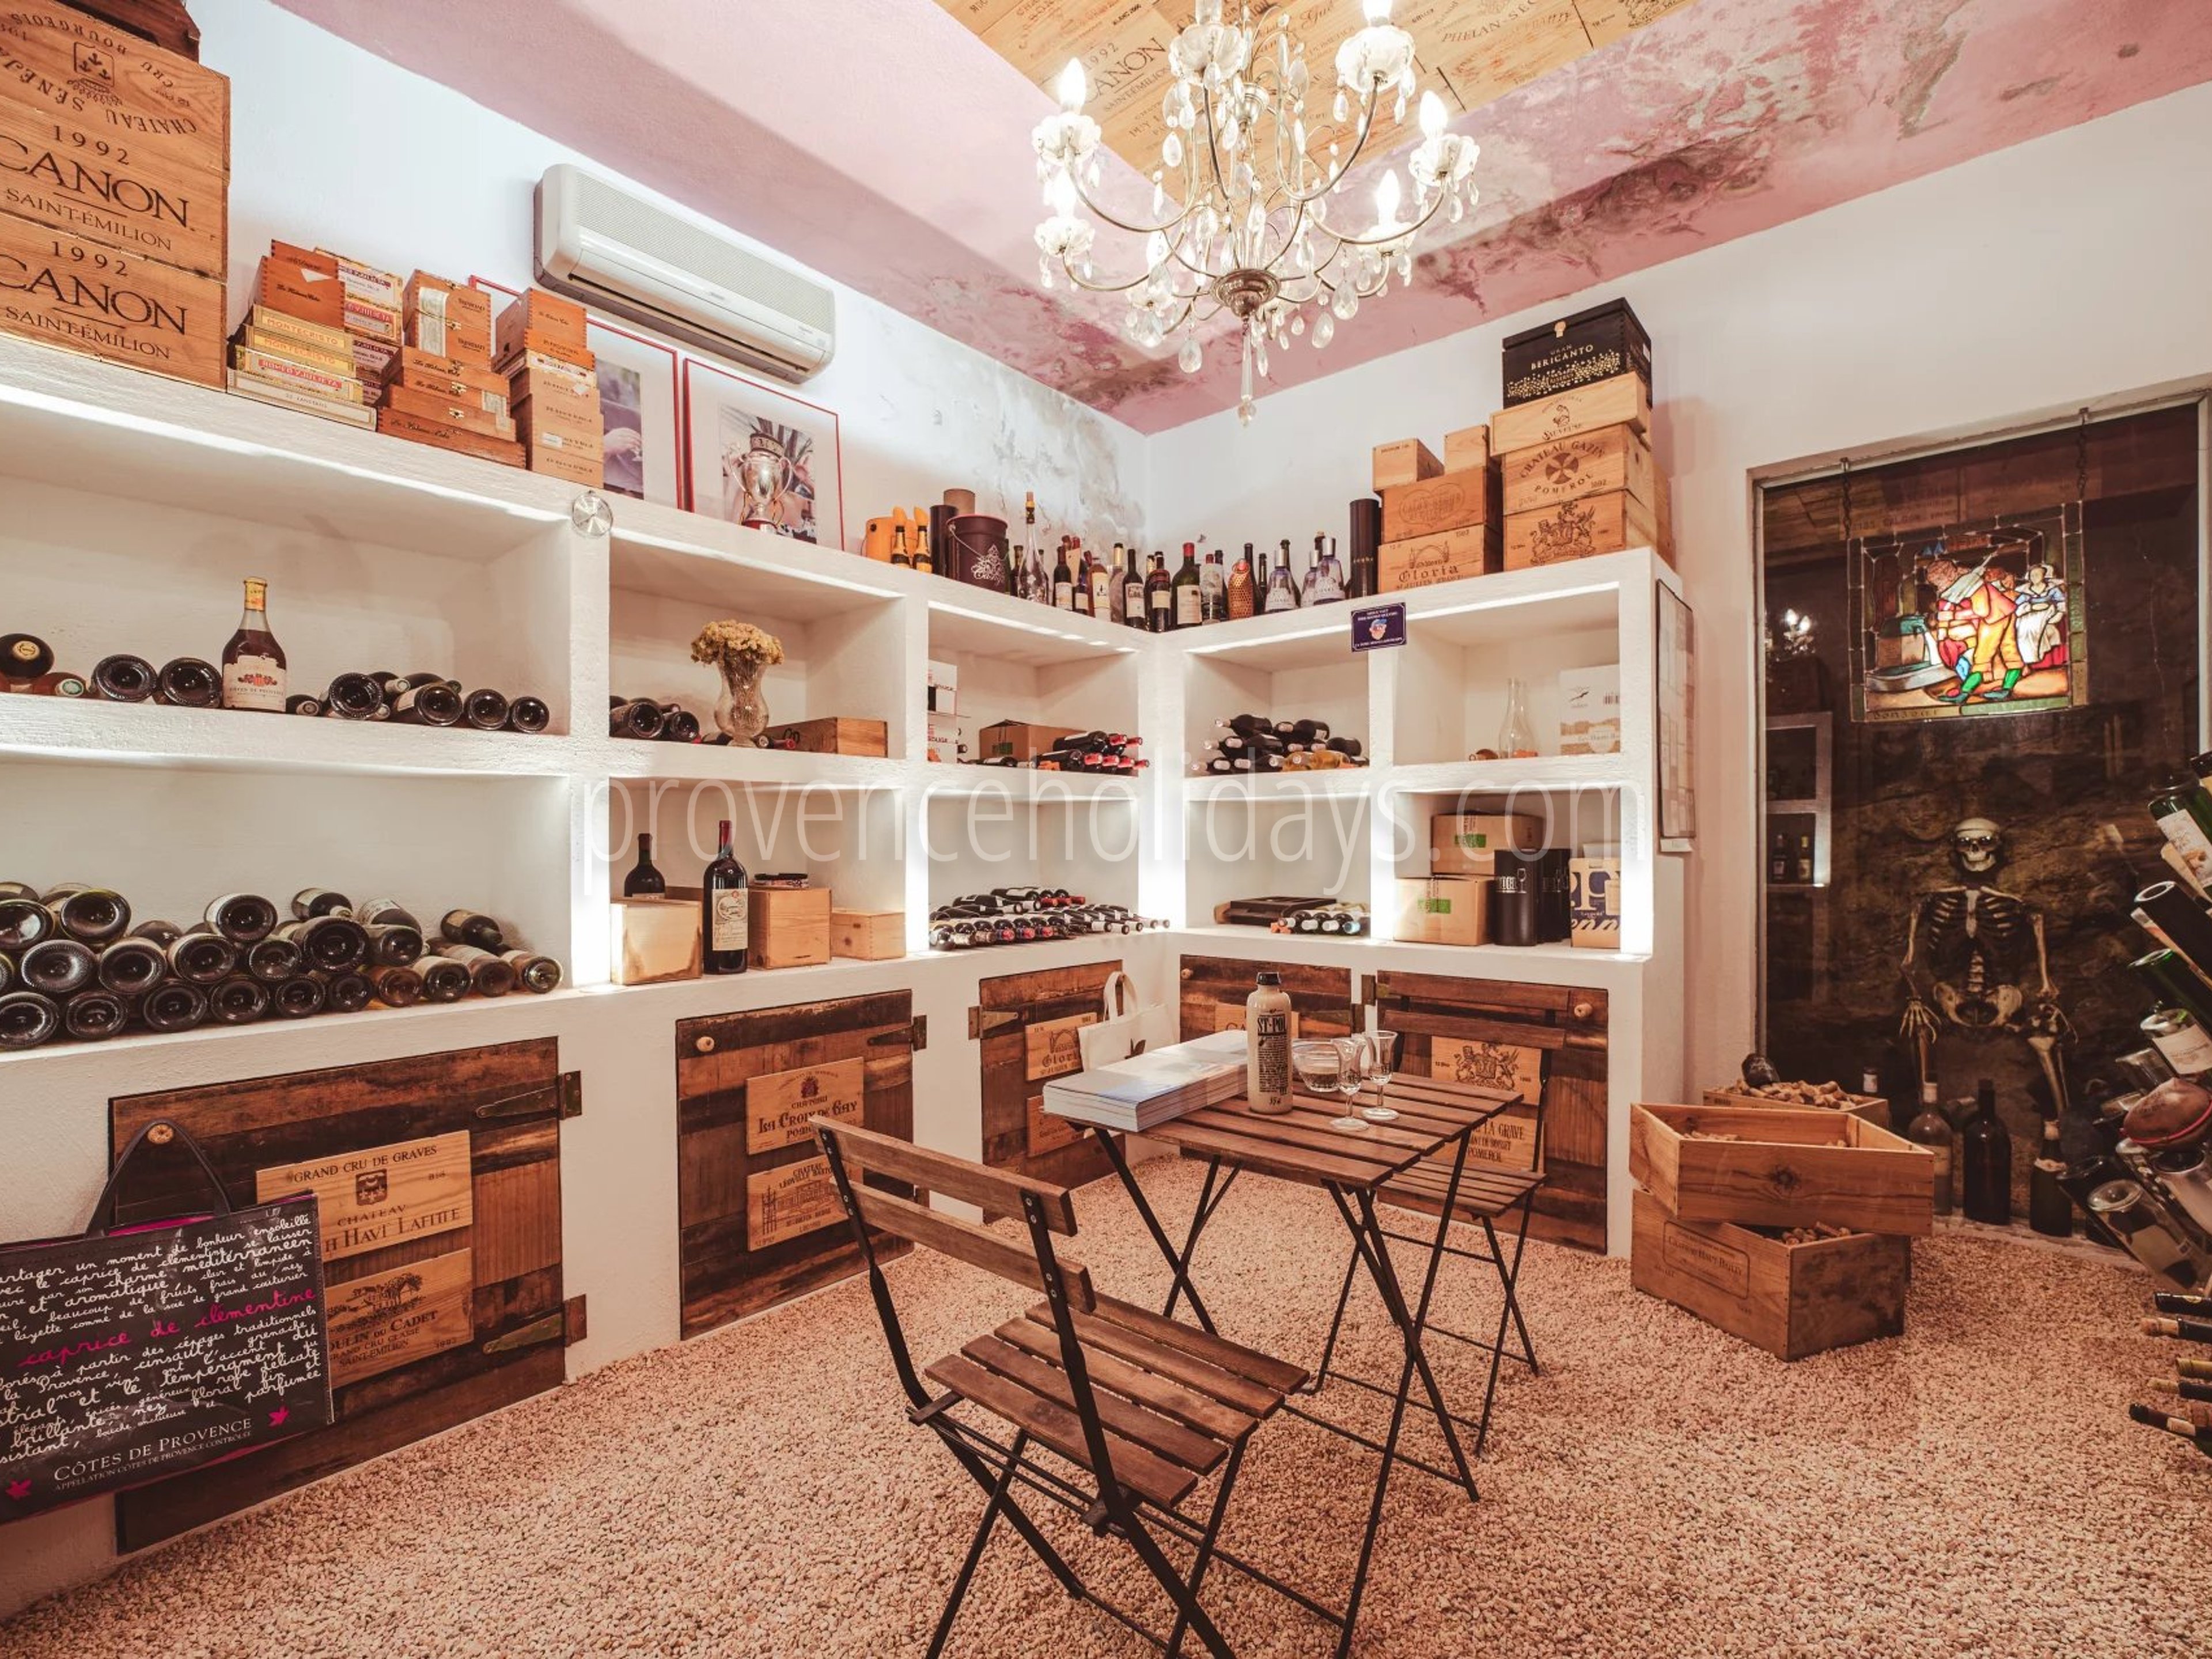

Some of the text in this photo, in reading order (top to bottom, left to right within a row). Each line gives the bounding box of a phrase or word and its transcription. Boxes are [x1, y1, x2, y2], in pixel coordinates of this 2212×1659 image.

[1085, 37, 1166, 103] ANON
[53, 125, 130, 165] 1992
[0, 134, 190, 228] CANON
[52, 241, 128, 276] 1992
[0, 253, 188, 336] CANON
[1531, 344, 1594, 370] BERICANTO
[294, 1145, 437, 1183] GRAND CRU DE GRAVES
[36, 1279, 51, 1290] le
[59, 1268, 122, 1286] caprice
[131, 1263, 150, 1272] de
[267, 1229, 312, 1243] laisser
[107, 1245, 162, 1266] moment
[196, 1233, 245, 1249] bonheur
[48, 1305, 114, 1323] beaucoup
[70, 1316, 111, 1330] comme
[214, 1285, 249, 1302] grand
[389, 1309, 439, 1331] CADET
[17, 1331, 132, 1368] caprice
[150, 1320, 181, 1338] de
[76, 1353, 132, 1376] partir
[142, 1347, 165, 1358] des
[233, 1305, 317, 1336] traditionnels
[4, 1388, 21, 1401] la
[78, 1387, 101, 1407] et
[54, 1418, 252, 1481] CÔTES DE PROVENCE
[161, 1446, 203, 1461] PROVENCE
